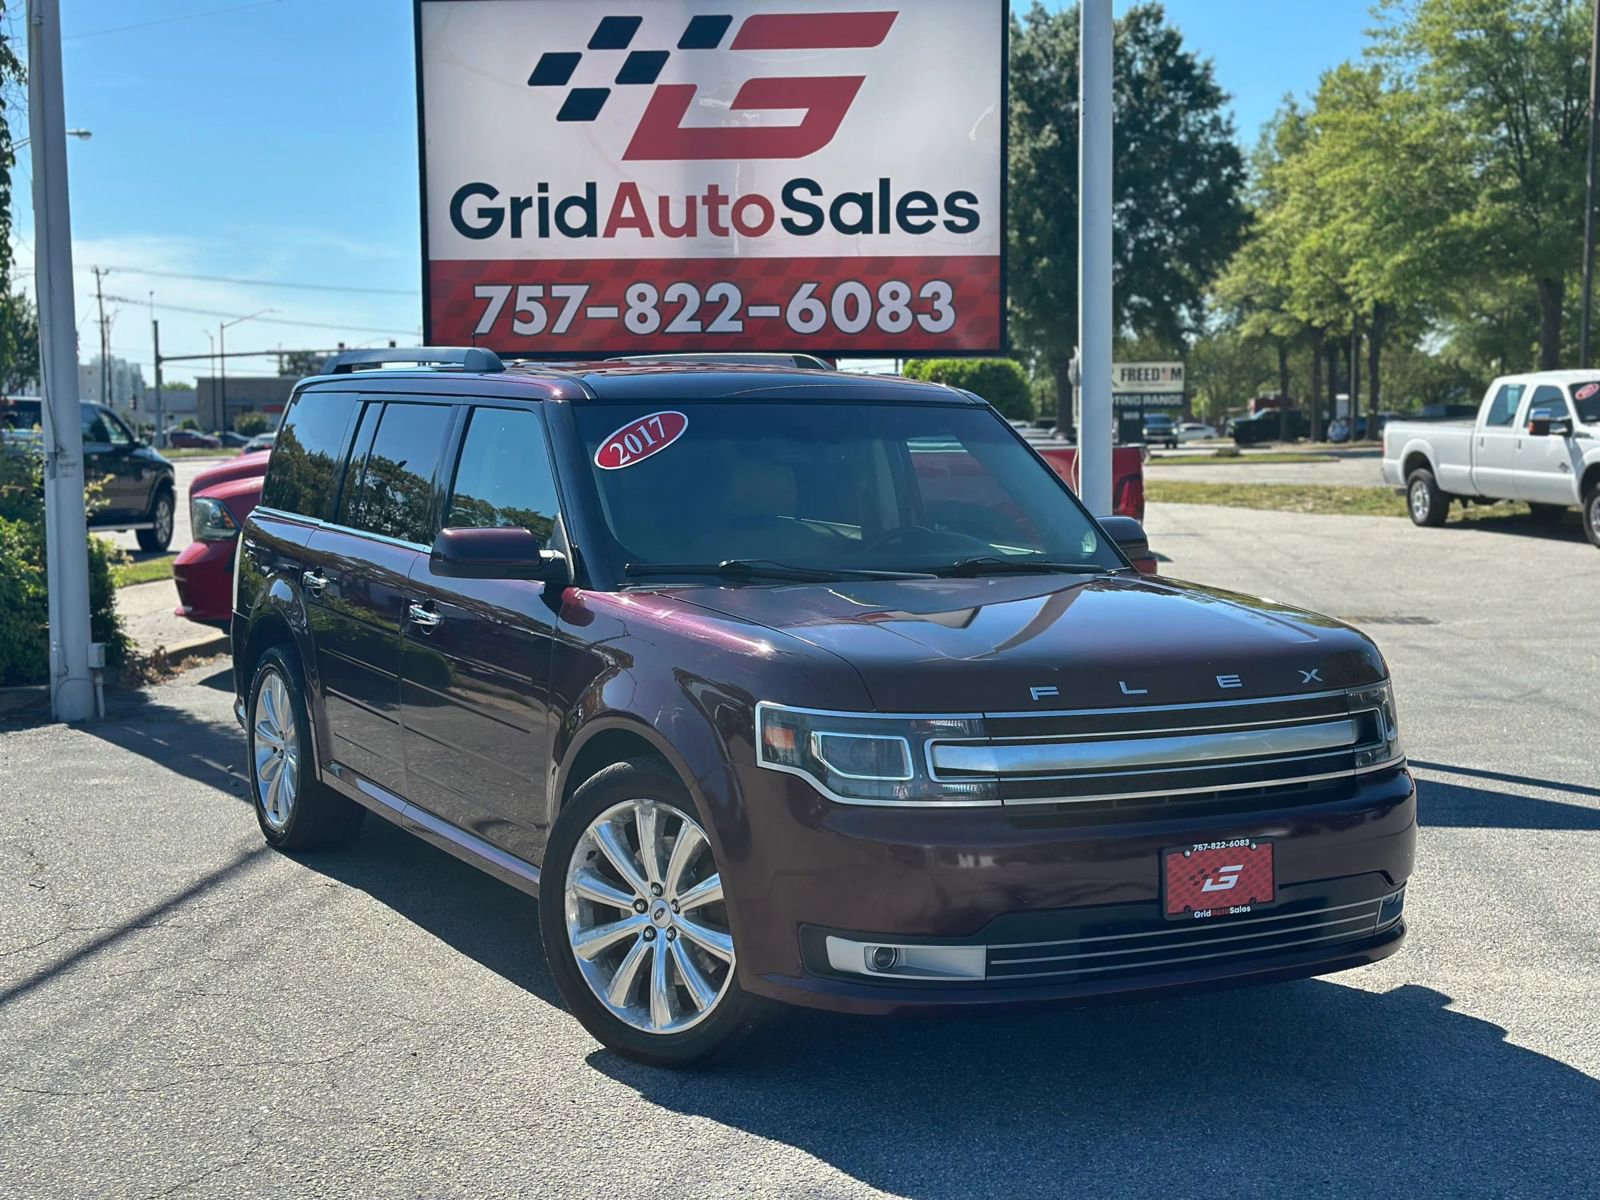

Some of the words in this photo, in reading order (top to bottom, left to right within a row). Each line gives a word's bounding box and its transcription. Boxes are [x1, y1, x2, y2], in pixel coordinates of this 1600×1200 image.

[449, 177, 981, 240] GridAutoSales
[472, 279, 956, 336] 757-822-6083
[1120, 367, 1182, 382] FREEDM
[1114, 395, 1142, 406] TING
[609, 415, 665, 465] 2017
[1029, 668, 1324, 701] FLEX
[1193, 838, 1250, 852] 757-822-6083
